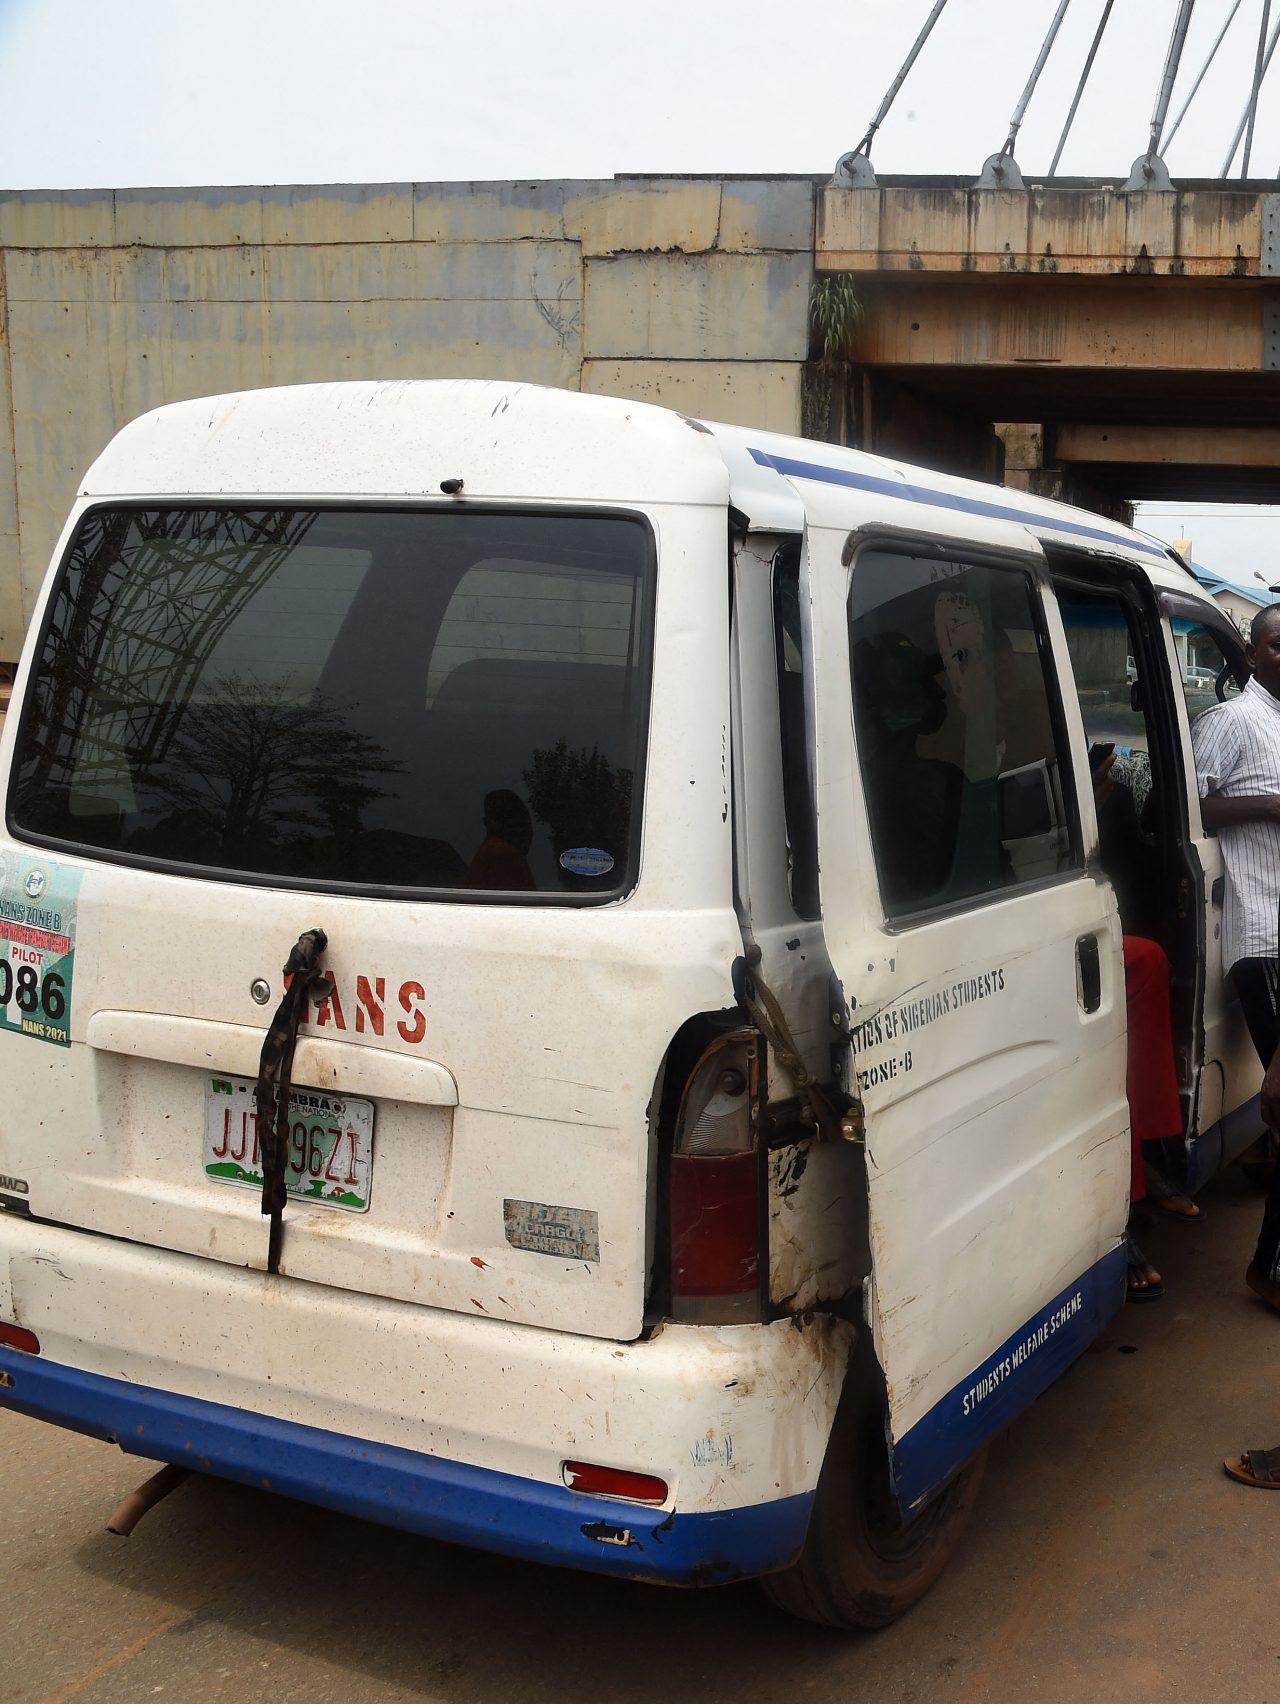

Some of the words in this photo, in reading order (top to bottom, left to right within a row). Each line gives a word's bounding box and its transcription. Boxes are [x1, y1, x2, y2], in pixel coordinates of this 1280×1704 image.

[53, 912, 61, 931] B
[12, 946, 44, 965] PILOT
[884, 1010, 899, 1040] OF
[900, 988, 950, 1034] NIGERIAN
[952, 968, 1005, 1009] STUDENTS
[22, 1019, 45, 1036] NANS
[46, 1025, 68, 1042] 2021
[962, 1357, 1011, 1416] STUDENTS
[1012, 1322, 1049, 1370] WELFARE
[1050, 1292, 1082, 1334] SCHEME
